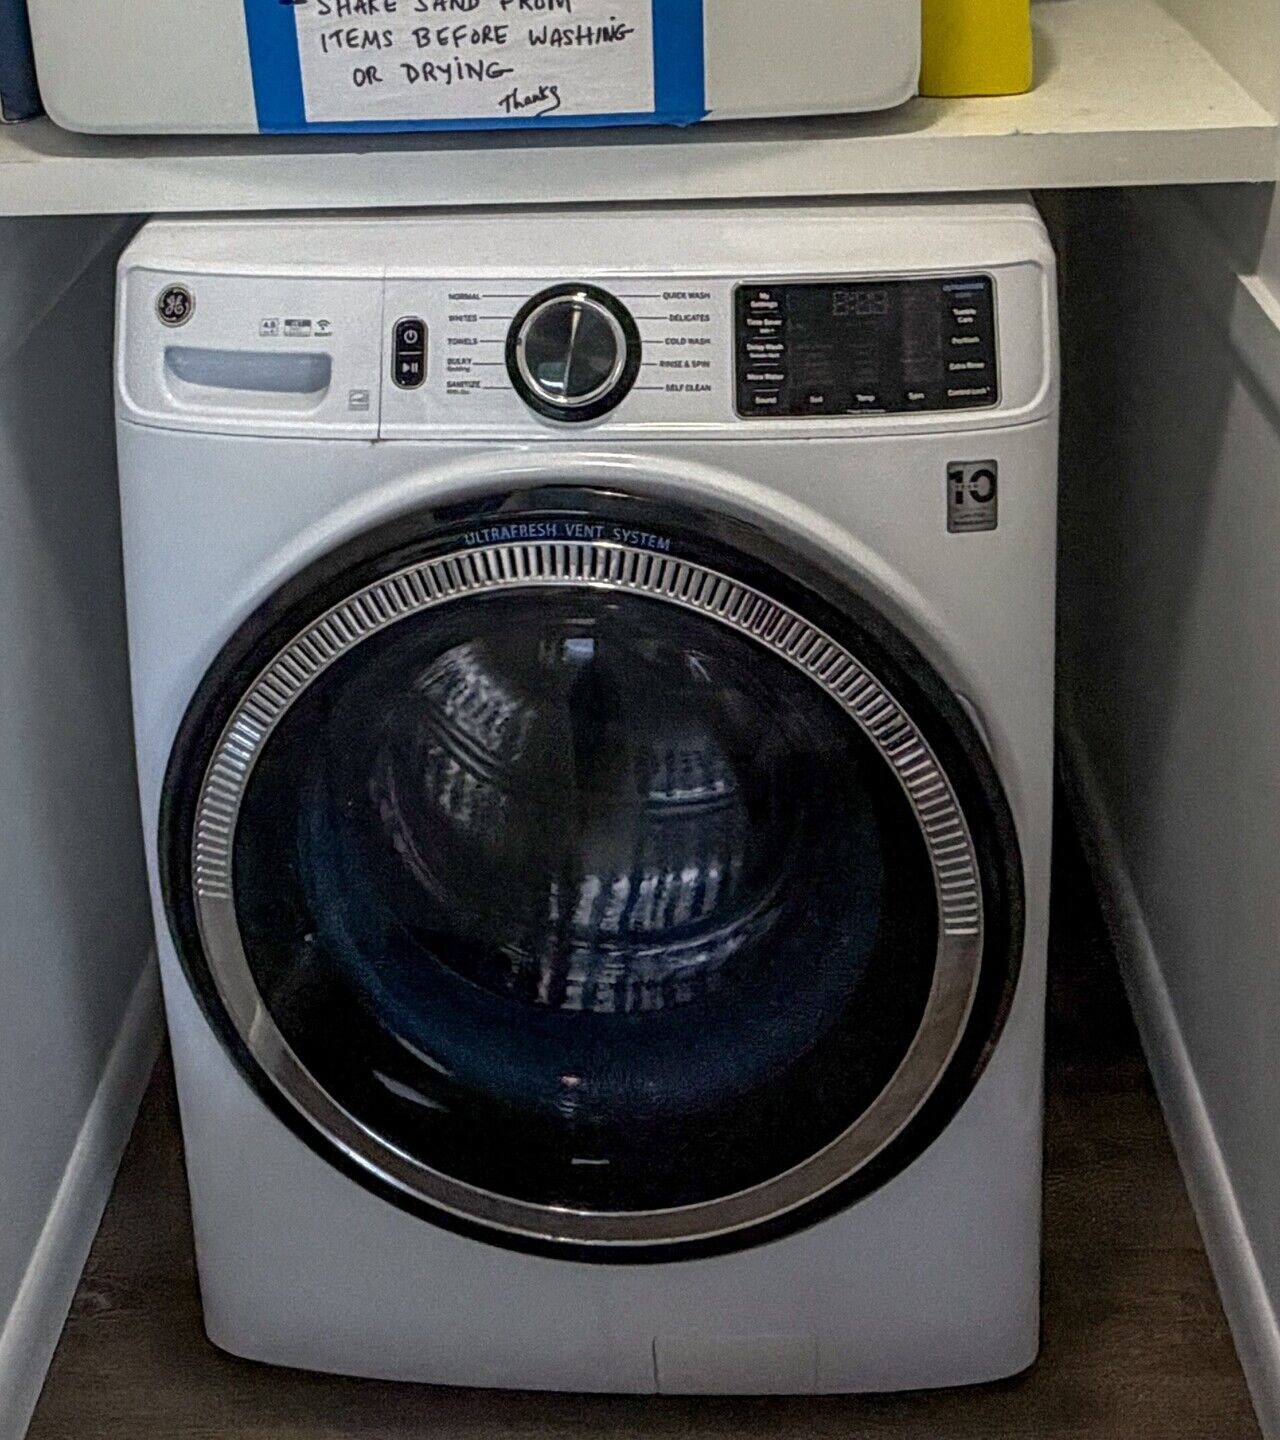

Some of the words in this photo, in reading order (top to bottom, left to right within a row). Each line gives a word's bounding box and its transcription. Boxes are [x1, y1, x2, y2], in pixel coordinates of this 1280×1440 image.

[320, 27, 394, 54] ITEMS
[411, 24, 510, 49] BEFORE
[528, 15, 635, 48] WASHING
[353, 65, 383, 87] OR
[400, 56, 515, 85] DRYING
[497, 84, 563, 119] Thanks
[663, 292, 687, 300] QUICK
[687, 292, 711, 300] WASH
[669, 314, 711, 322] DELICATES
[664, 337, 687, 345] COLD
[687, 337, 711, 345] WASH
[659, 360, 683, 368] RINSE
[683, 360, 690, 368] &
[691, 360, 711, 368] SPIN
[666, 384, 685, 392] SELF
[684, 384, 712, 392] CLEAN
[464, 523, 558, 546] ULTRAFRESH
[564, 523, 605, 539] VENT
[612, 528, 672, 552] SYSTEM
